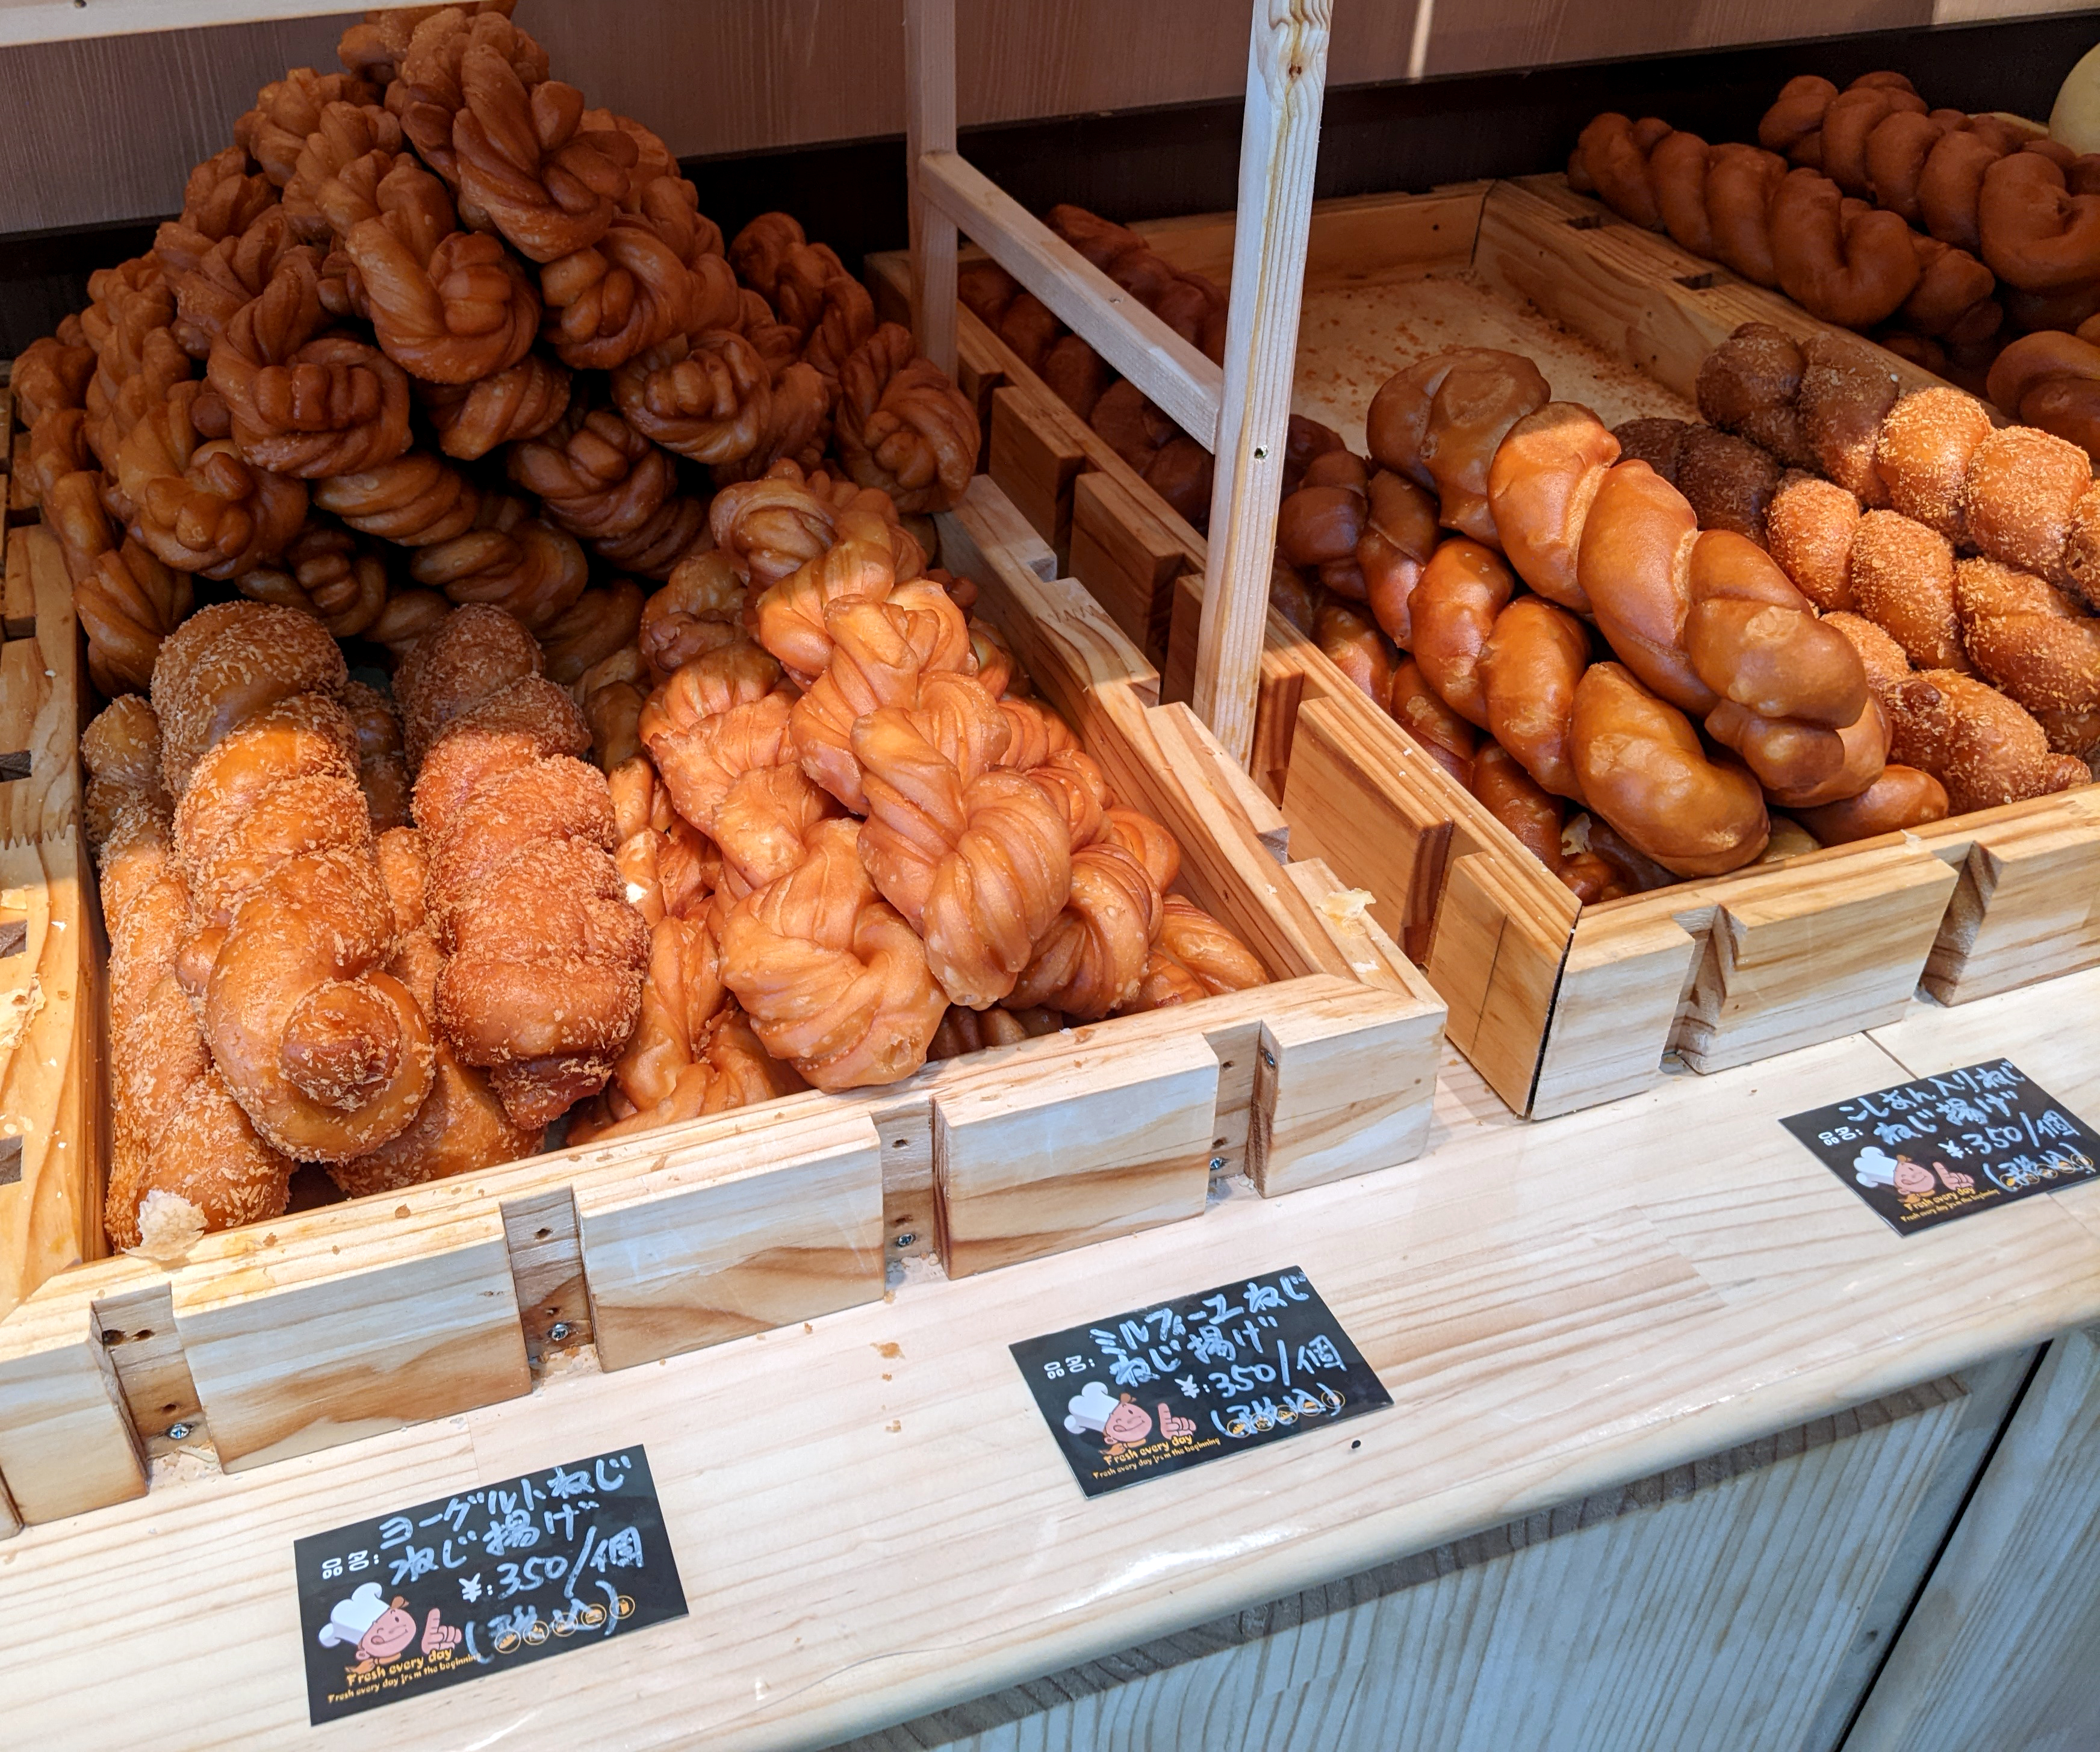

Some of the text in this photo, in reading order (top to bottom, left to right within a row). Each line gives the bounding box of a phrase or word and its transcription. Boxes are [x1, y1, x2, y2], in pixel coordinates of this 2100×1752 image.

[1904, 1187, 1975, 1211] Fresh every day
[1092, 1468, 1116, 1479] Fresh
[1117, 1462, 1137, 1471] every
[1139, 1458, 1152, 1466] day
[1172, 1447, 1184, 1456] the
[1185, 1437, 1221, 1452] beginning
[1103, 1435, 1193, 1465] Fresh every day
[328, 1689, 354, 1703] Fresh
[356, 1683, 380, 1696] every
[382, 1677, 398, 1688] day
[423, 1665, 438, 1676] the
[346, 1648, 452, 1686] Fresh every day
